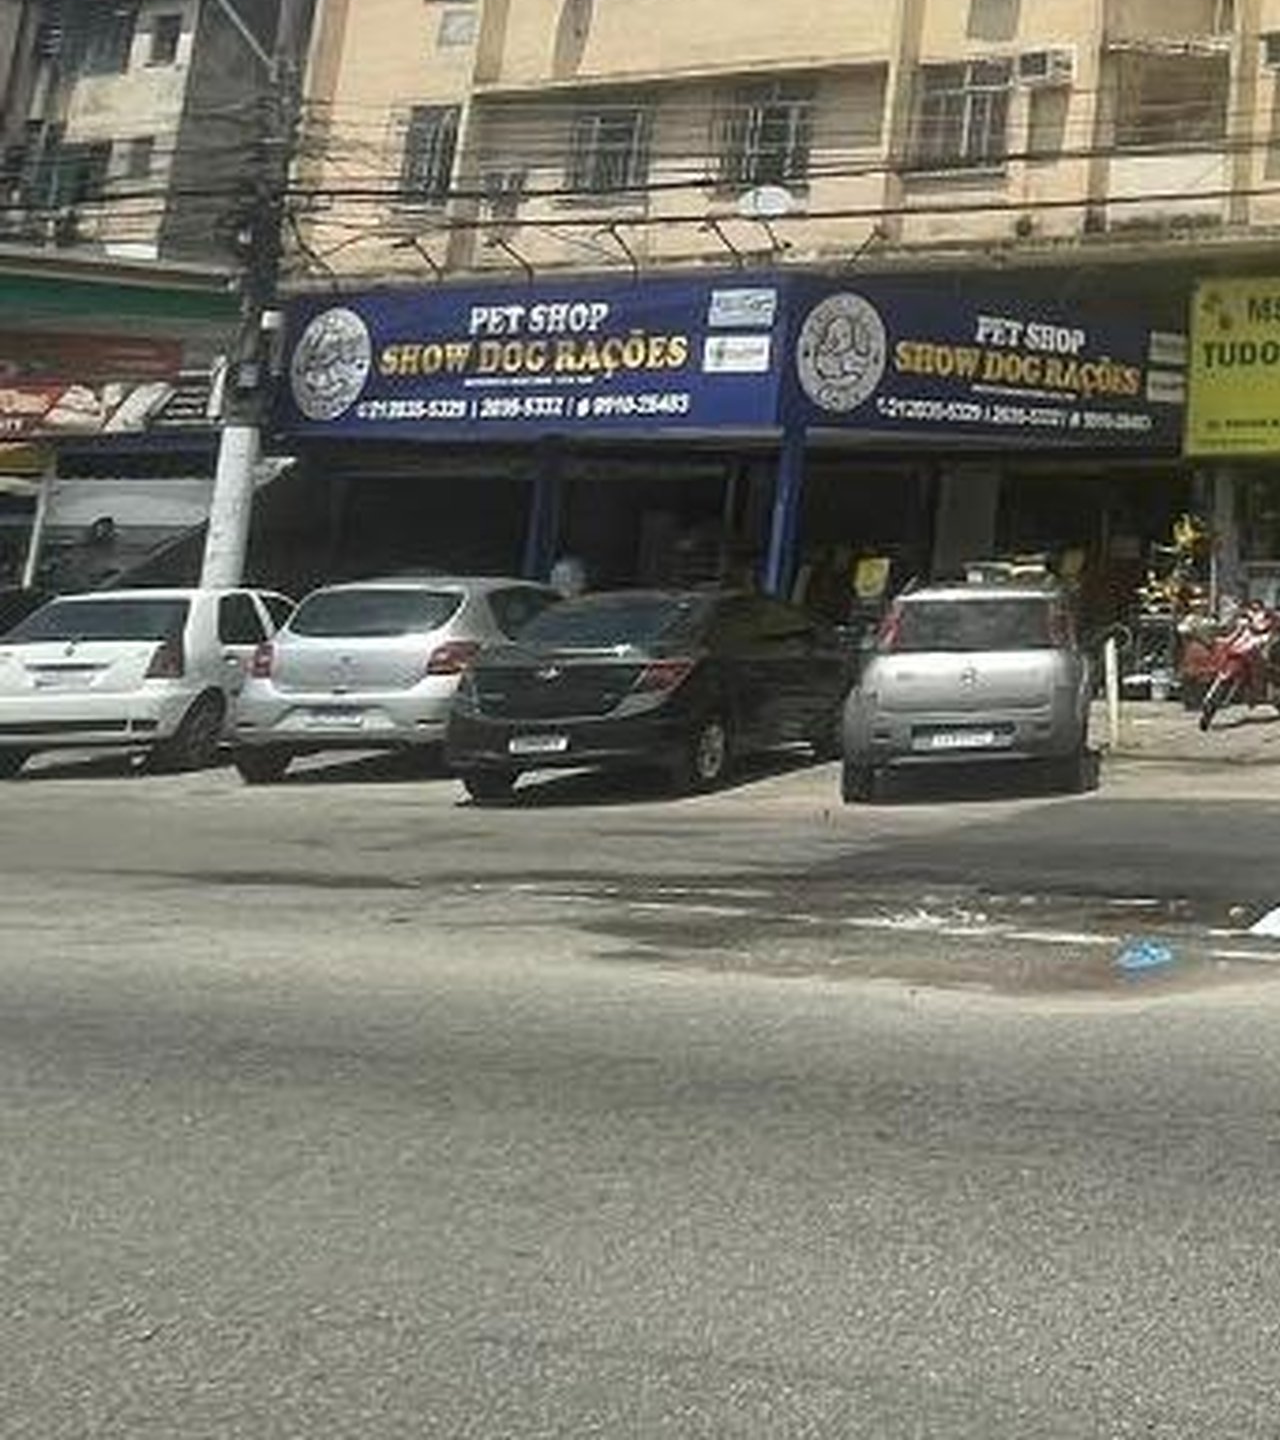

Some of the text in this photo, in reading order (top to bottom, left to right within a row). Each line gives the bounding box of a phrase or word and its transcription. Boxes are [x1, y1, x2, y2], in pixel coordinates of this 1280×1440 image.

[469, 303, 610, 334] PET SHOP
[976, 317, 1084, 354] PET SHOP
[379, 341, 473, 376] SHOW
[477, 337, 546, 373] DOG
[555, 329, 690, 378] RAÇÕES
[894, 342, 978, 377] SHOW
[984, 352, 1042, 385] DOG
[1047, 356, 1140, 396] RAÇÕES
[1203, 339, 1280, 368] TUDO
